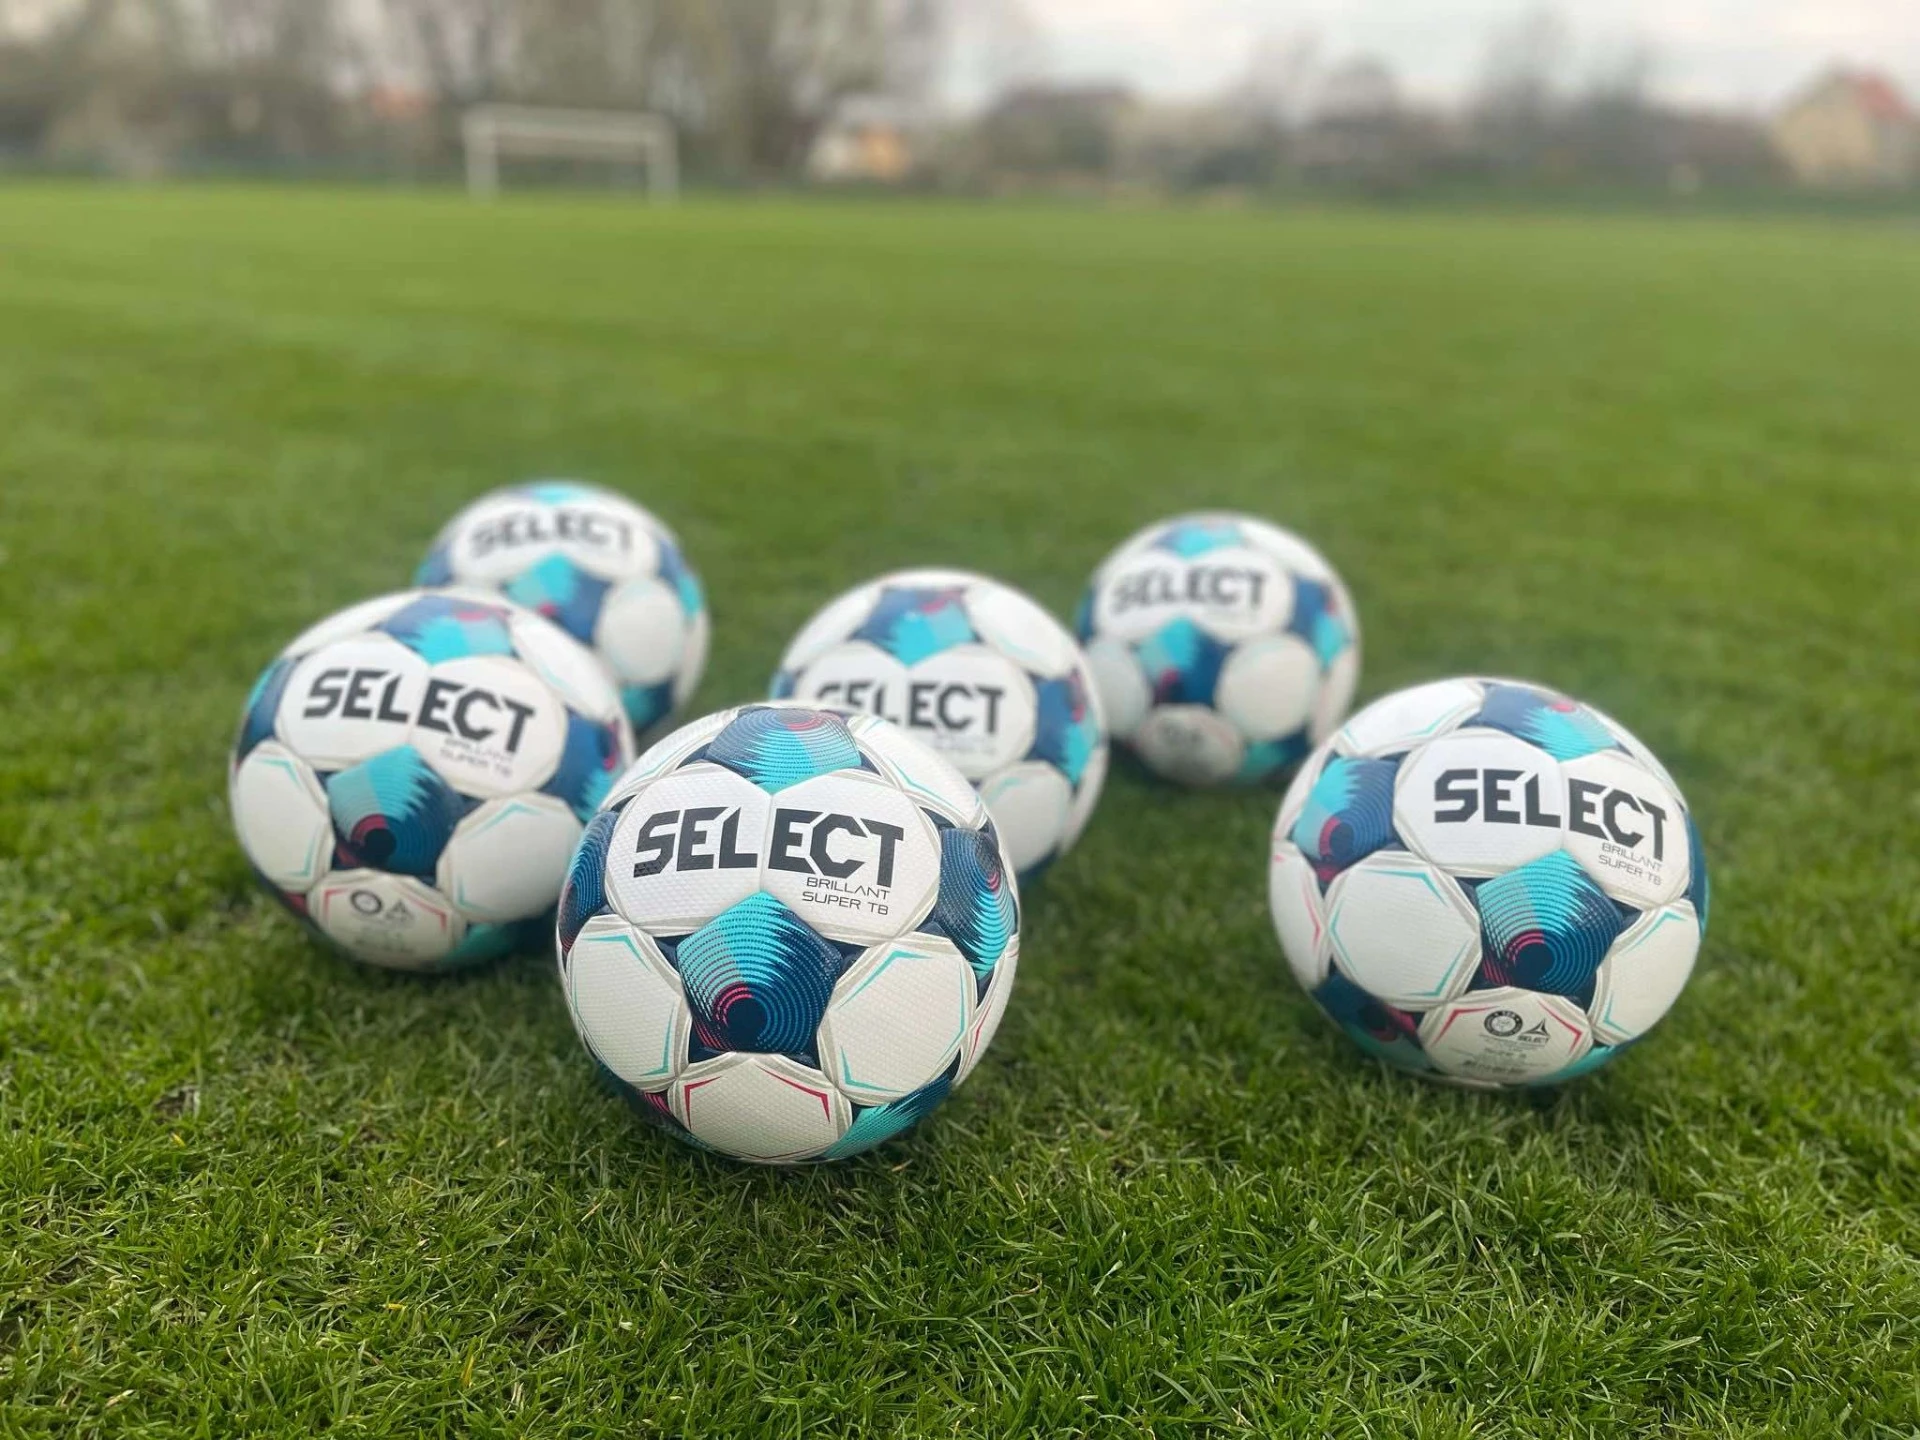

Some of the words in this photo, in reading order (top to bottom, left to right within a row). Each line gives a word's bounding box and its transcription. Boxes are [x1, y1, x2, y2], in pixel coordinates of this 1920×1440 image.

[474, 511, 633, 558] SELECT
[1111, 567, 1266, 613] SELECT
[303, 669, 534, 753] SELECT
[1434, 768, 1668, 862] SELECT
[633, 806, 904, 888] SELECT
[1598, 854, 1644, 877] SUPER
[1601, 842, 1663, 872] BRILLANT
[802, 891, 861, 910] SUPER
[806, 876, 890, 900] BRILLANT
